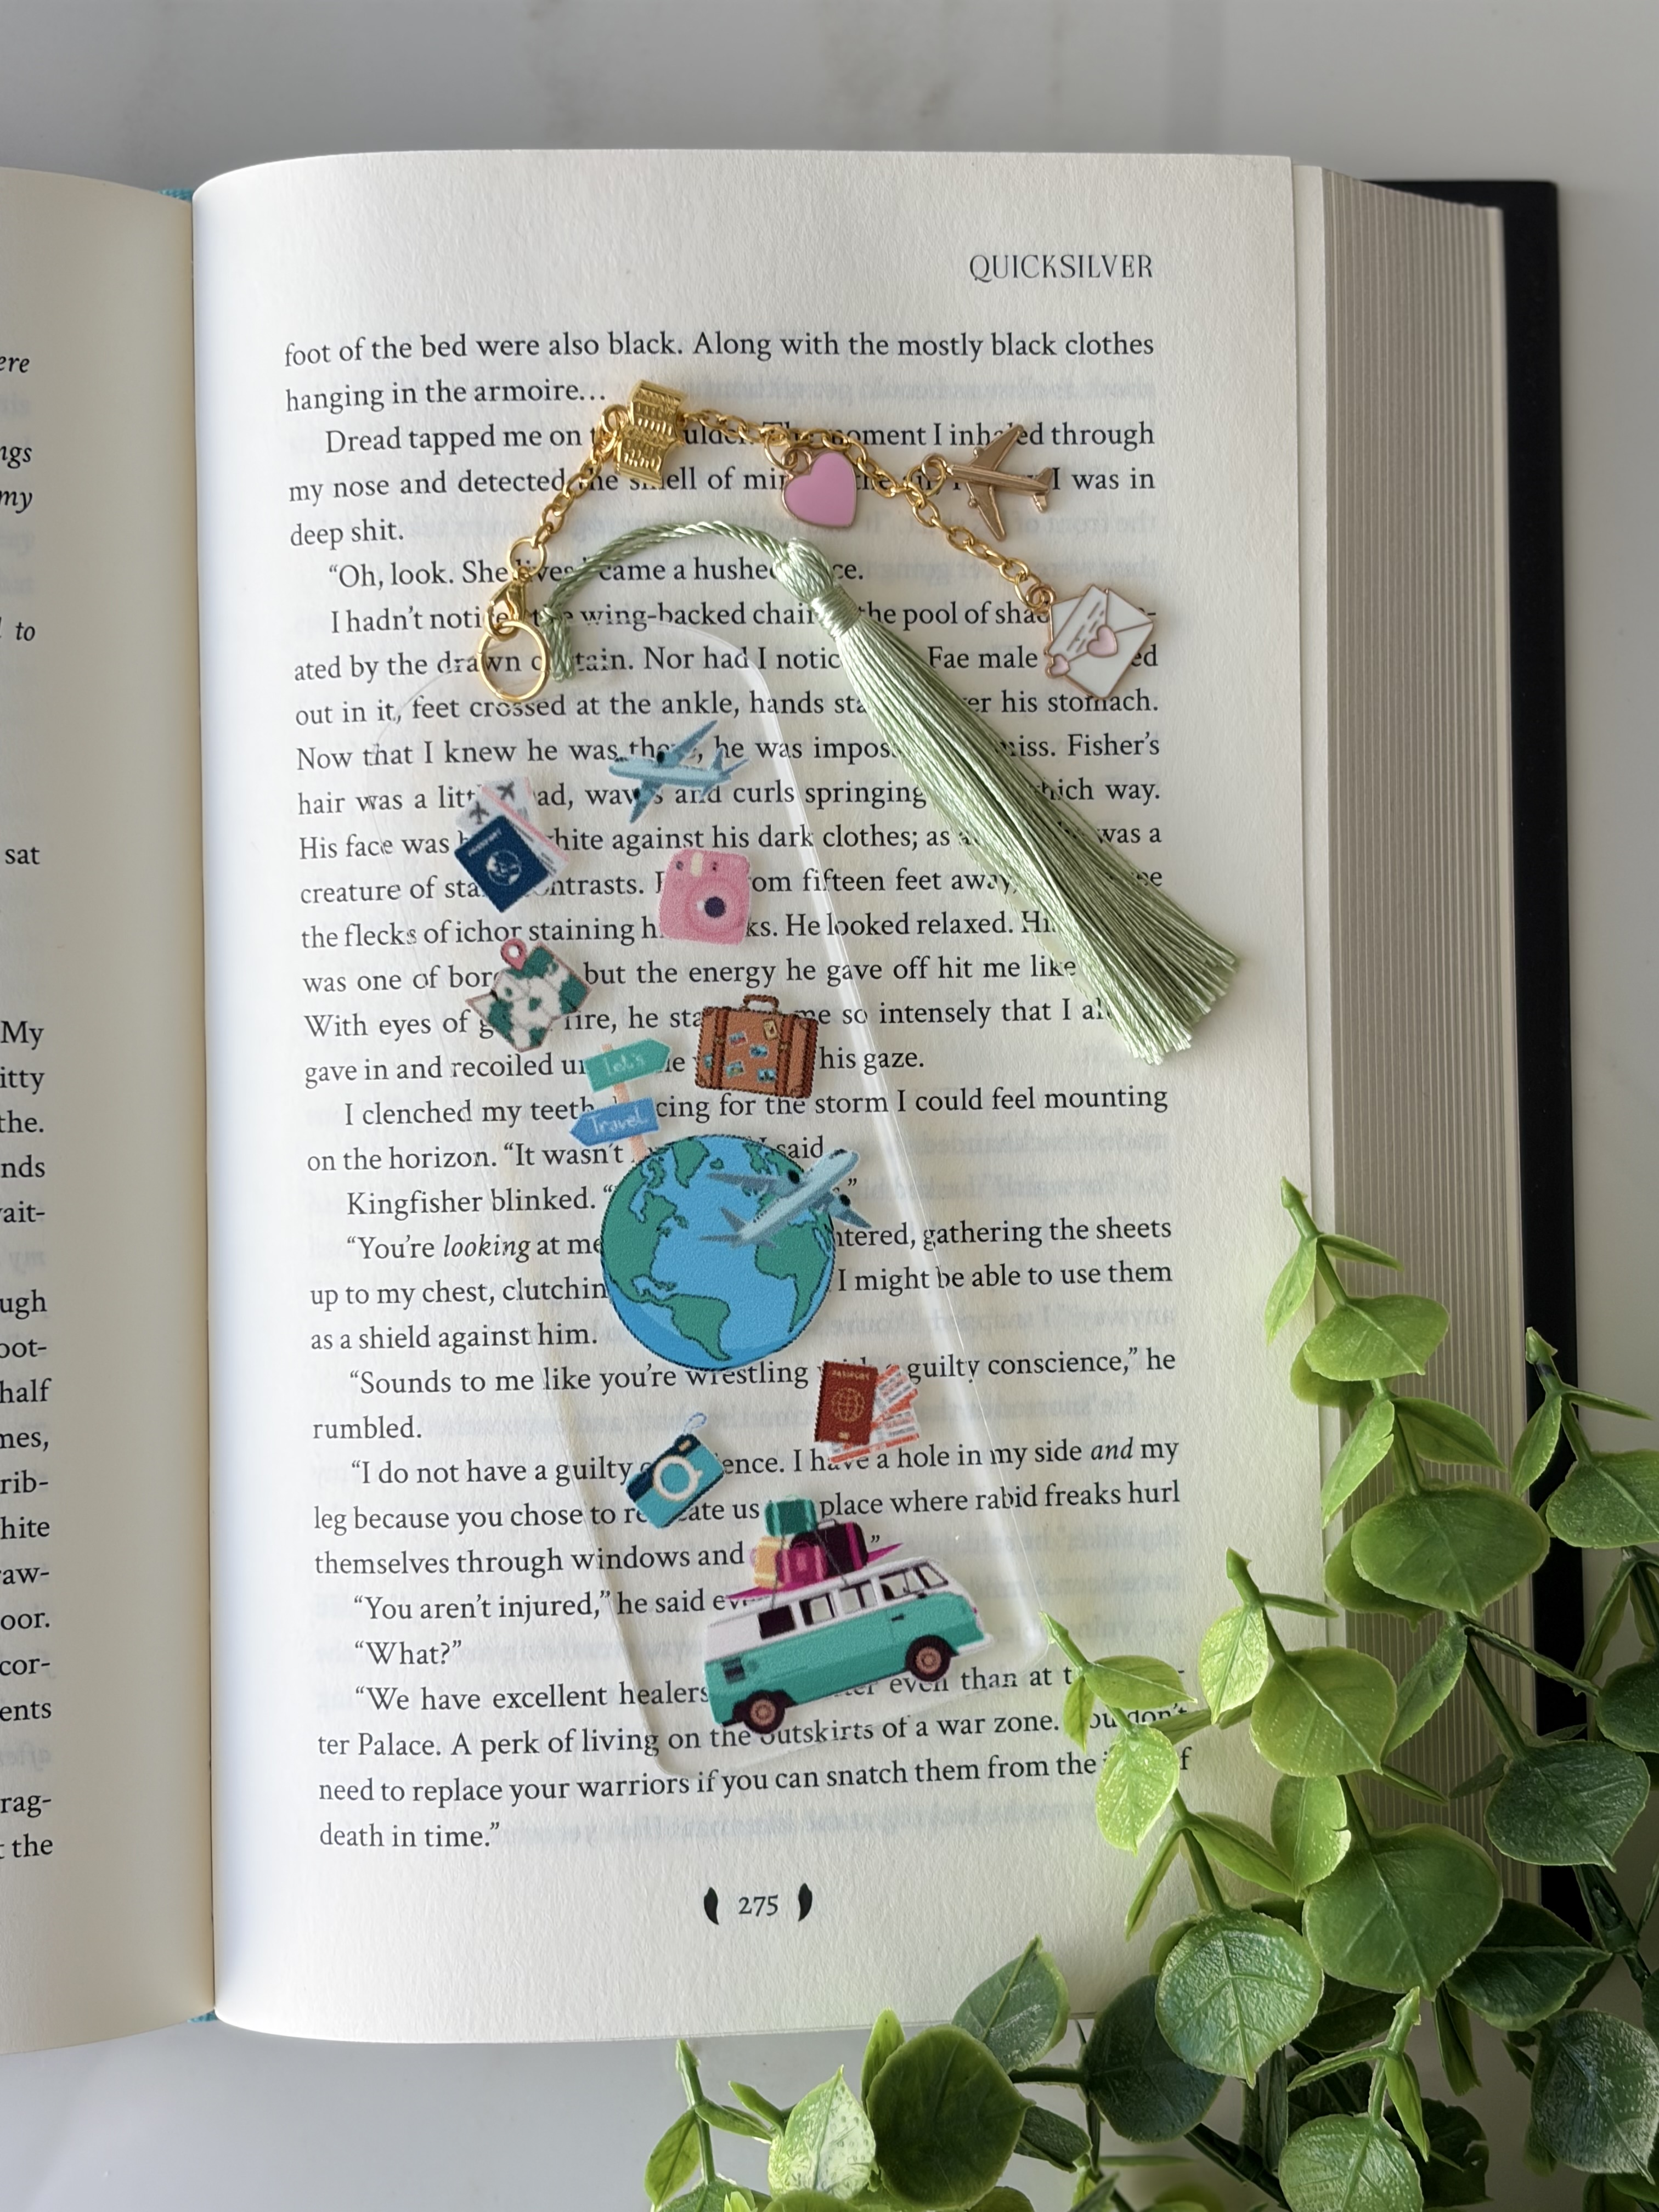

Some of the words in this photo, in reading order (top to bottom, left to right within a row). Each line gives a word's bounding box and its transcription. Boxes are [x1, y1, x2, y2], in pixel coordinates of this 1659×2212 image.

[969, 254, 1153, 284] QUICKSILVER
[285, 342, 331, 367] foot
[338, 336, 366, 362] of
[371, 335, 413, 360] the
[420, 332, 467, 358] bed
[475, 339, 540, 357] were
[548, 331, 600, 356] also
[607, 330, 683, 356] black.
[692, 330, 772, 362] Along
[779, 330, 840, 356] with
[848, 331, 889, 356] the
[897, 331, 984, 364] mostly
[990, 331, 1058, 356] black
[1065, 330, 1154, 356] clothes
[285, 384, 385, 415] hanging
[392, 381, 419, 404] in
[425, 378, 467, 404] the
[325, 425, 402, 454] Dread
[408, 422, 496, 456] tapped
[502, 430, 543, 447] me
[549, 430, 583, 447] on
[933, 422, 943, 446] I
[1050, 420, 1155, 452] through
[290, 522, 344, 551] deep
[351, 517, 404, 543] shit.
[15, 621, 36, 642] to
[295, 706, 333, 726] out
[342, 701, 367, 723] in
[376, 698, 402, 724] it,
[411, 694, 460, 719] feet
[469, 693, 567, 718] crossed
[576, 697, 600, 716] at
[609, 691, 652, 715] the
[661, 689, 740, 719] ankle,
[748, 689, 825, 715] hands
[1001, 689, 1039, 713] his
[4, 846, 41, 866] sat
[301, 925, 338, 949] the
[345, 921, 417, 947] flecks
[423, 918, 452, 945] of
[455, 918, 523, 943] ichor
[528, 917, 635, 946] staining
[785, 913, 821, 937] He
[826, 911, 911, 936] looked
[916, 910, 1014, 935] relaxed.
[302, 976, 347, 993] was
[357, 974, 402, 991] one
[412, 964, 442, 990] of
[582, 961, 627, 985] but
[635, 959, 678, 984] the
[688, 965, 777, 989] energy
[785, 957, 816, 981] he
[826, 963, 883, 988] gave
[893, 955, 932, 980] off
[937, 955, 973, 979] hit
[983, 961, 1021, 978] me
[1030, 953, 1077, 978] like
[0, 1020, 45, 1051] My
[305, 1065, 358, 1090] gave
[364, 1058, 390, 1081] in
[396, 1054, 443, 1080] and
[450, 1052, 554, 1078] recoiled
[819, 1045, 857, 1070] his
[863, 1052, 924, 1076] gaze.
[345, 1103, 353, 1126] I
[362, 1098, 473, 1126] clenched
[481, 1105, 523, 1129] my
[719, 1092, 759, 1116] for
[764, 1097, 806, 1116] the
[815, 1094, 889, 1115] storm
[896, 1088, 907, 1113] I
[915, 1086, 984, 1112] could
[991, 1085, 1036, 1110] feel
[1043, 1084, 1169, 1114] mounting
[588, 1104, 650, 1136] Travel
[347, 1188, 484, 1222] Kingfisher
[490, 1185, 596, 1212] blinked.
[347, 1234, 435, 1260] “You’re
[443, 1233, 532, 1264] looking
[536, 1236, 561, 1256] at
[923, 1219, 1043, 1252] gathering
[1048, 1216, 1090, 1241] the
[1096, 1215, 1172, 1240] sheets
[311, 1334, 334, 1350] as
[340, 1333, 353, 1350] a
[358, 1324, 431, 1350] shield
[438, 1324, 531, 1355] against
[537, 1321, 598, 1346] him.
[349, 1368, 452, 1395] “Sounds
[460, 1373, 486, 1393] to
[495, 1374, 535, 1392] me
[543, 1365, 591, 1391] like
[599, 1362, 677, 1397] you’re
[988, 1346, 1138, 1376] conscience,”
[1145, 1346, 1176, 1370] he
[0, 1377, 53, 1404] half
[313, 1414, 422, 1440] rumbled.
[314, 1505, 347, 1537] leg
[353, 1505, 450, 1530] because
[455, 1511, 504, 1536] you
[510, 1502, 584, 1527] chose
[589, 1505, 617, 1526] to
[889, 1488, 969, 1514] where
[975, 1483, 1039, 1511] rabid
[1044, 1481, 1122, 1507] freaks
[1127, 1479, 1181, 1504] hurl
[314, 1550, 450, 1575] themselves
[456, 1547, 564, 1579] through
[569, 1544, 691, 1571] windows
[697, 1540, 745, 1567] and
[353, 1595, 413, 1620] “You
[420, 1593, 492, 1620] aren’t
[498, 1589, 611, 1625] injured,”
[616, 1590, 648, 1616] he
[654, 1587, 706, 1614] said
[354, 1639, 462, 1665] “What?”
[317, 1736, 351, 1756] ter
[358, 1731, 442, 1757] Palace.
[450, 1731, 472, 1756] A
[479, 1729, 540, 1763] perk
[548, 1730, 577, 1753] of
[581, 1727, 660, 1757] living
[668, 1732, 702, 1750] on
[709, 1728, 752, 1748] the
[759, 1718, 874, 1746] outskirts
[882, 1716, 908, 1739] of
[915, 1720, 929, 1737] a
[935, 1718, 986, 1736] war
[994, 1714, 1059, 1734] zone.
[319, 1777, 375, 1801] need
[380, 1782, 405, 1802] to
[412, 1776, 503, 1809] replace
[508, 1782, 570, 1808] your
[575, 1772, 690, 1798] warriors
[696, 1768, 718, 1793] if
[720, 1773, 769, 1799] you
[775, 1771, 820, 1790] can
[826, 1759, 909, 1787] snatch
[913, 1757, 981, 1783] them
[987, 1754, 1050, 1779] from
[1056, 1750, 1097, 1776] the
[11, 1832, 54, 1859] the
[319, 1821, 385, 1847] death
[392, 1824, 417, 1848] in
[424, 1821, 500, 1848] time.”
[738, 1893, 779, 1917] 275
